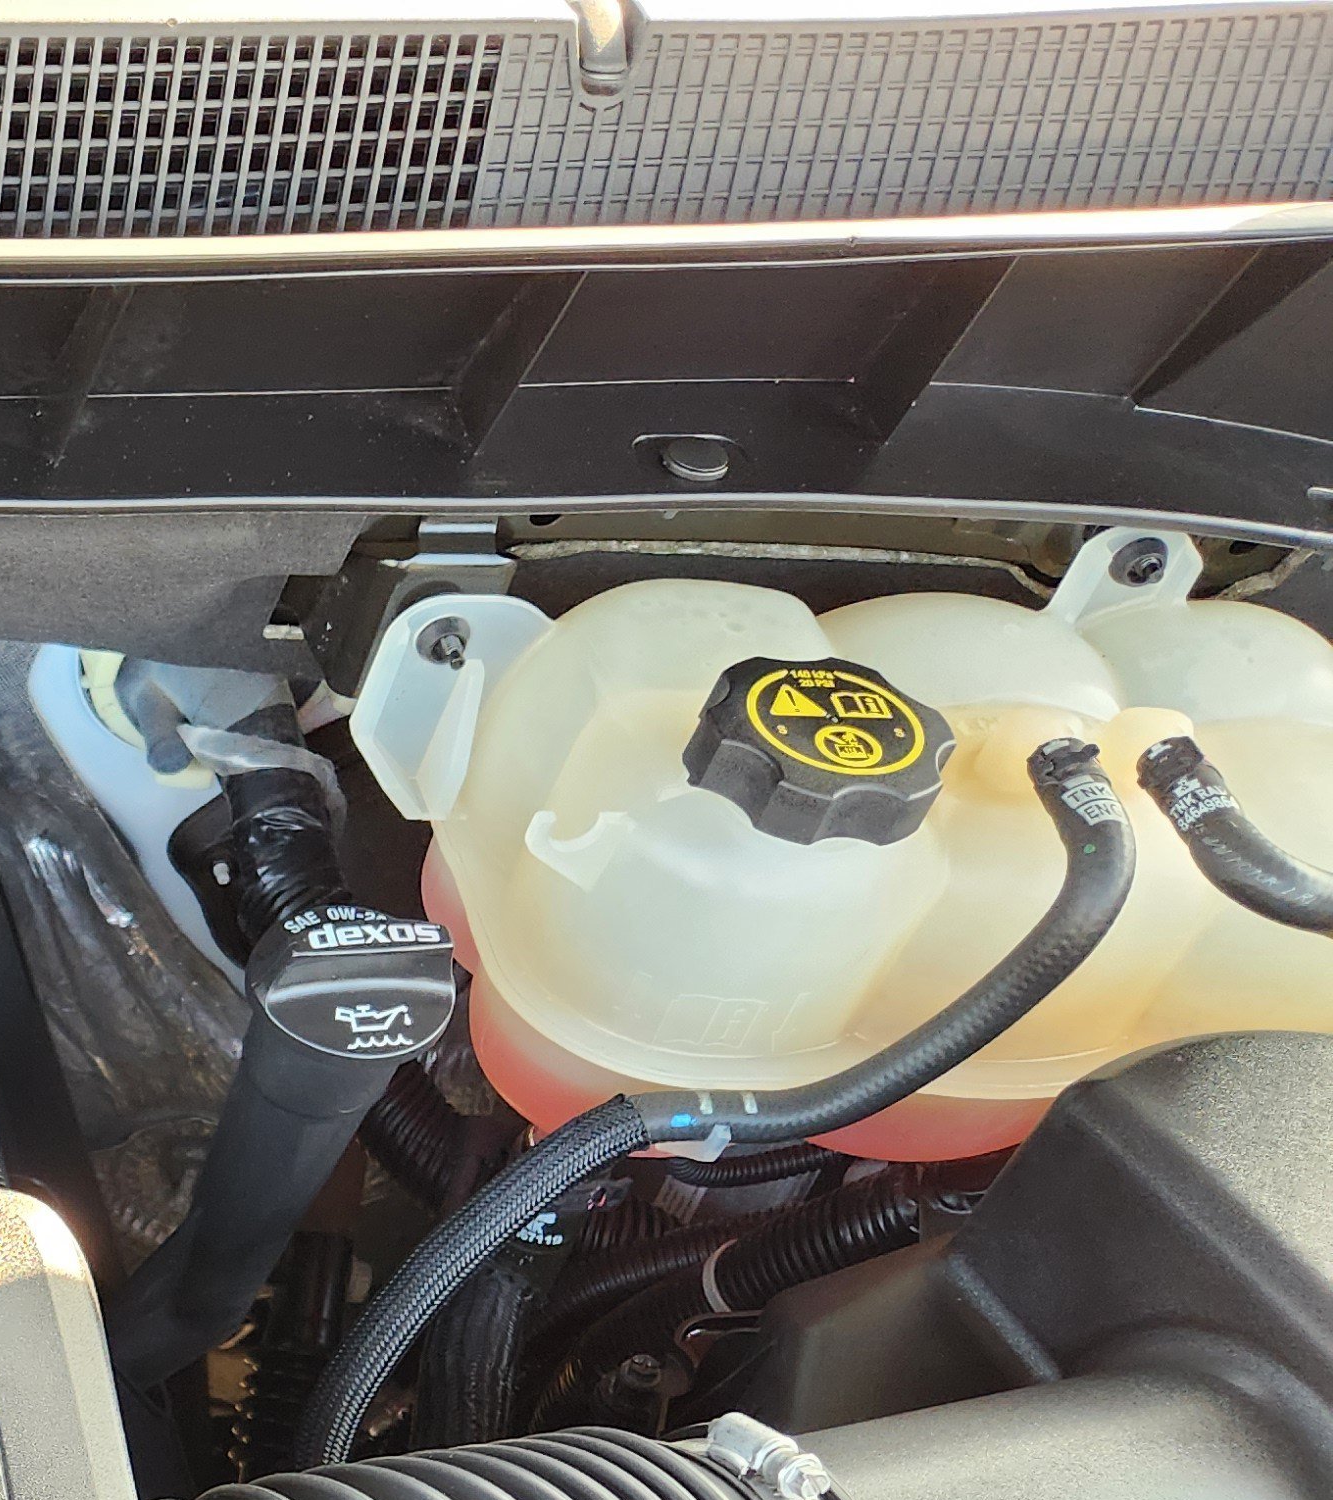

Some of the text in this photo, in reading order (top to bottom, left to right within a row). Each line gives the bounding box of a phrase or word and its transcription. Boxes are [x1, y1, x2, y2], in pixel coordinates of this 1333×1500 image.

[789, 669, 836, 680] 140 kPa
[799, 679, 836, 688] 20 PSI
[1170, 793, 1198, 819] TNK
[284, 910, 321, 934] SAE
[308, 923, 441, 949] dexos
